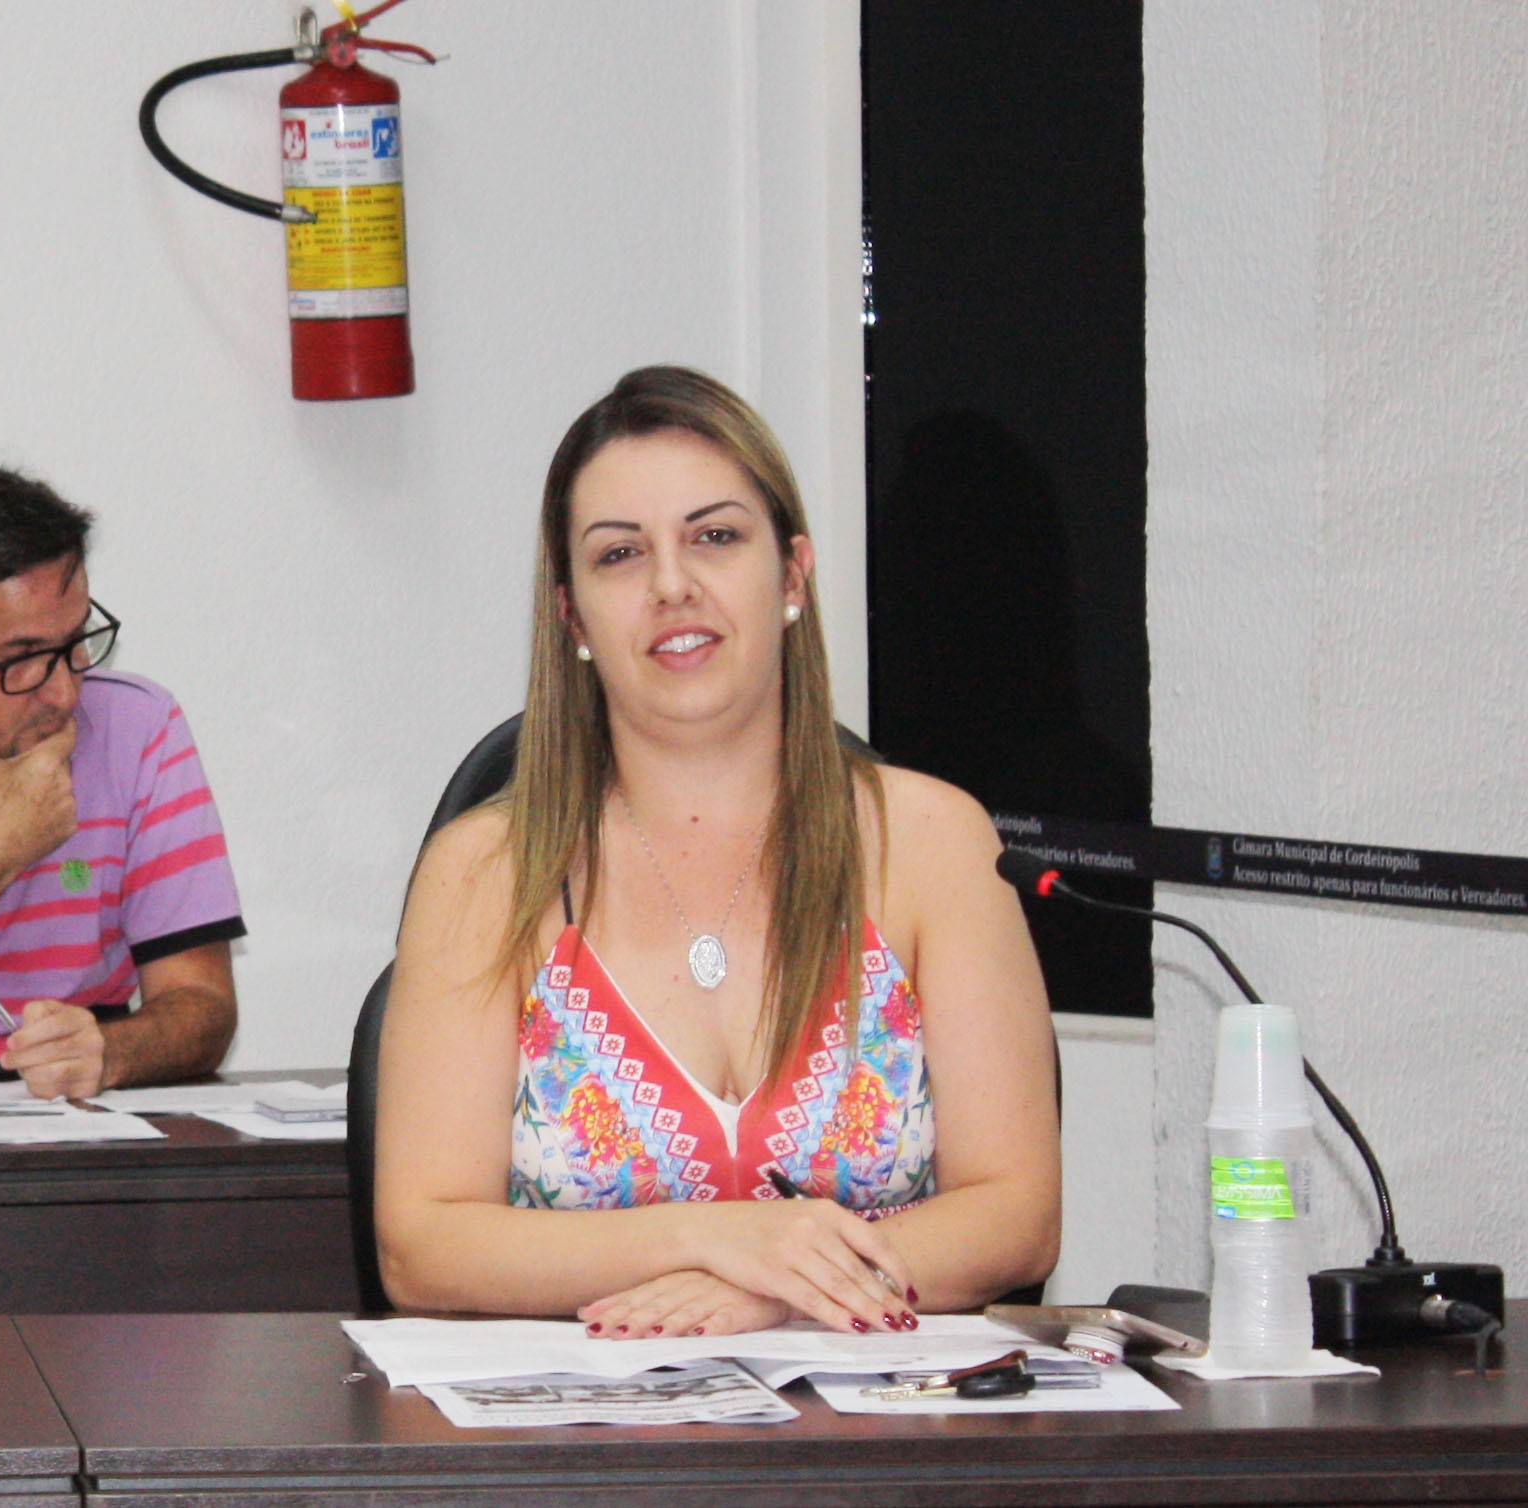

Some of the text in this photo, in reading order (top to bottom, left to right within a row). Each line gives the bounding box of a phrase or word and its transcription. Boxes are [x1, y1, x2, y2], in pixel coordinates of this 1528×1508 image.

[310, 129, 369, 139] extinores
[992, 813, 1042, 836] deirópolis
[1070, 851, 1076, 864] e
[1232, 837, 1420, 874] Câmara Municipal de Cordeirópolis
[1233, 864, 1269, 884] Acesso
[1270, 868, 1310, 888] restrito
[1312, 874, 1350, 893] apenas
[1352, 878, 1378, 898] para
[1380, 878, 1449, 901] funcionários
[1451, 888, 1459, 903] e
